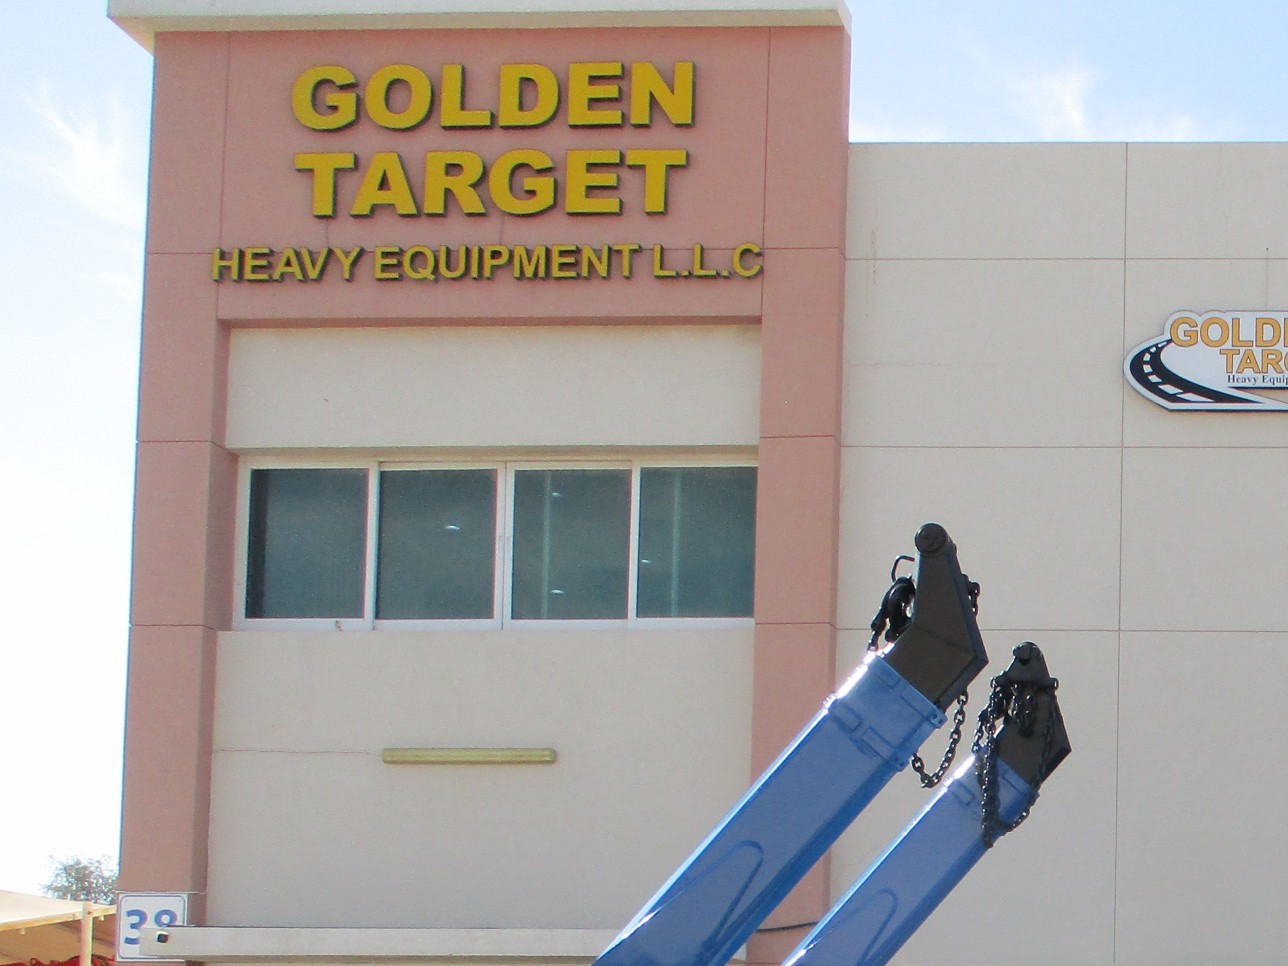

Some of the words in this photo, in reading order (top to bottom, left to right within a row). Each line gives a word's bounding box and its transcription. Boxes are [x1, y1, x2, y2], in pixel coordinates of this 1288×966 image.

[292, 61, 695, 130] GOLDEN
[294, 149, 688, 218] TARGET
[211, 246, 365, 282] HEAVY
[373, 242, 642, 282] EQUIPMENT
[653, 242, 763, 279] L.L.C
[1227, 374, 1258, 385] Heavy
